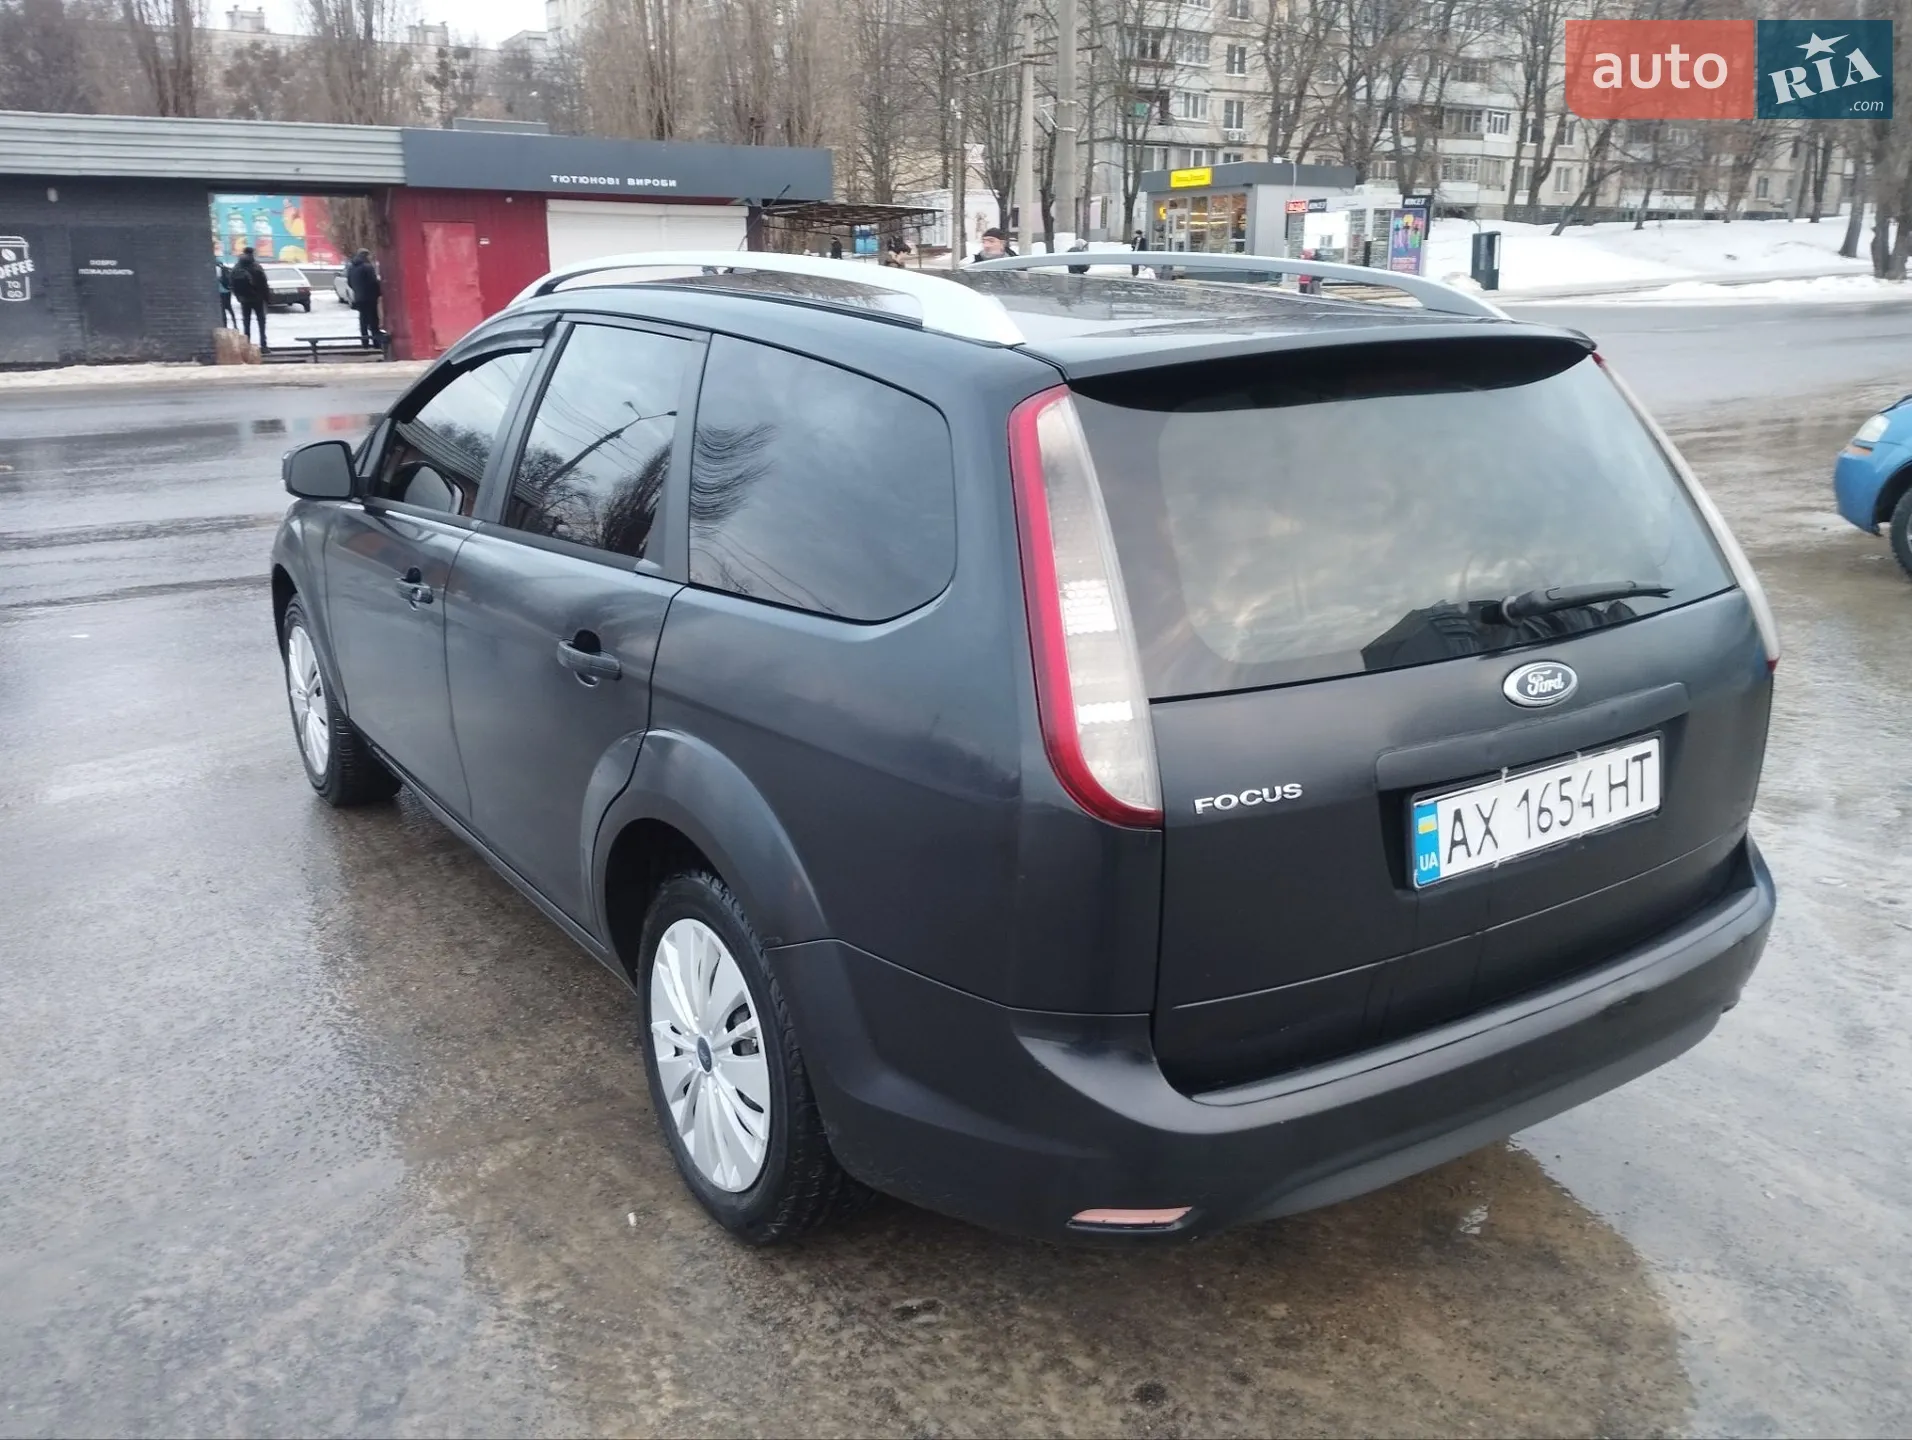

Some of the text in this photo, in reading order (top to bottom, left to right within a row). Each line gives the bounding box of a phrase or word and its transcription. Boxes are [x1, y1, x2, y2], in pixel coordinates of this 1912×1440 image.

[550, 174, 677, 188] ТЮТЮНОВІ ВИРОБИ
[0, 259, 35, 280] OFFEE
[5, 280, 22, 289] TO
[1526, 669, 1565, 696] Ford
[1194, 783, 1303, 815] FOCUS
[1446, 750, 1652, 864] AX 1654 HT
[1419, 851, 1439, 871] UA
